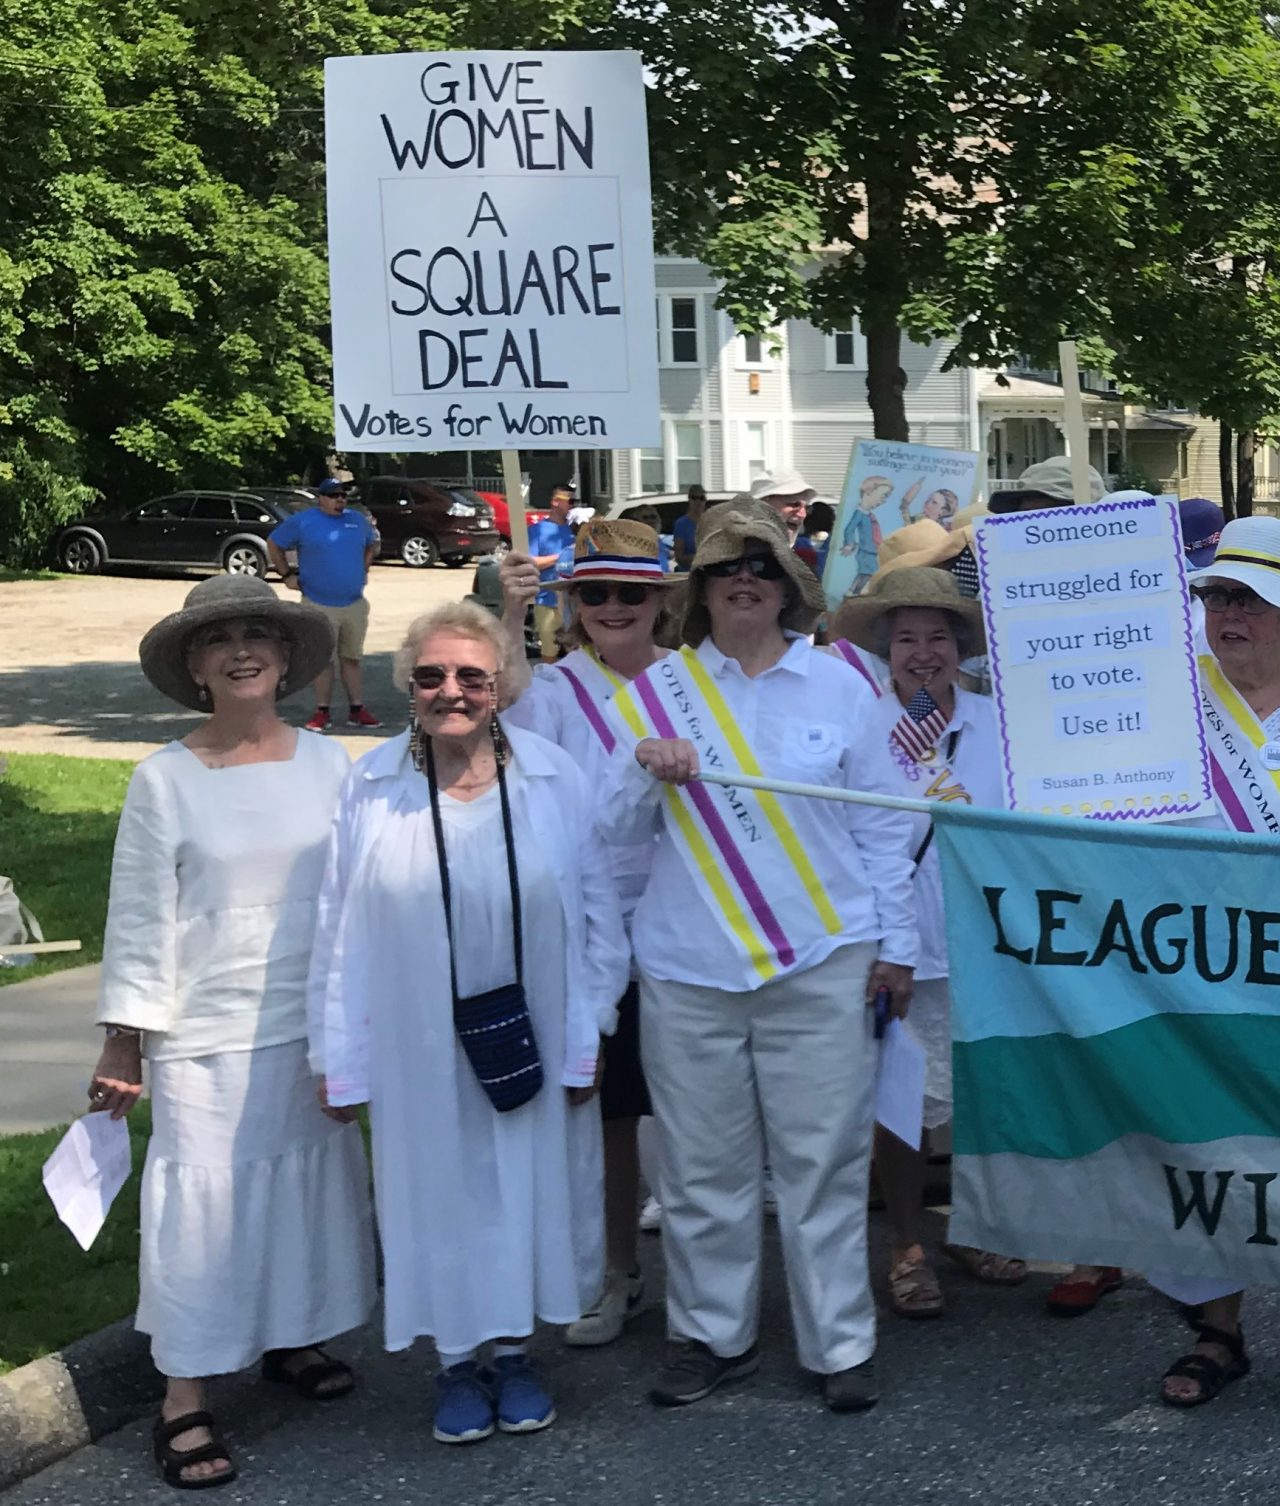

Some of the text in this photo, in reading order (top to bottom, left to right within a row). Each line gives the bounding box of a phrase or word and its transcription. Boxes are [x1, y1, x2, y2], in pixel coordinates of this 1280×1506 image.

[421, 61, 544, 105] GIVE
[380, 106, 593, 171] WOMEN
[467, 191, 508, 238] A
[390, 243, 621, 316] SQUARE
[419, 328, 569, 390] DEAL
[339, 402, 608, 438] Votes for Women
[1025, 519, 1138, 545] Someone
[1005, 569, 1163, 600] struggled for
[1026, 623, 1153, 660] your right
[1051, 666, 1142, 691] to vote.
[661, 663, 693, 714] OTES
[686, 716, 704, 741] for
[1062, 712, 1142, 736] Use it!
[1220, 733, 1238, 757] for
[1042, 769, 1175, 790] Susan B. Anthony
